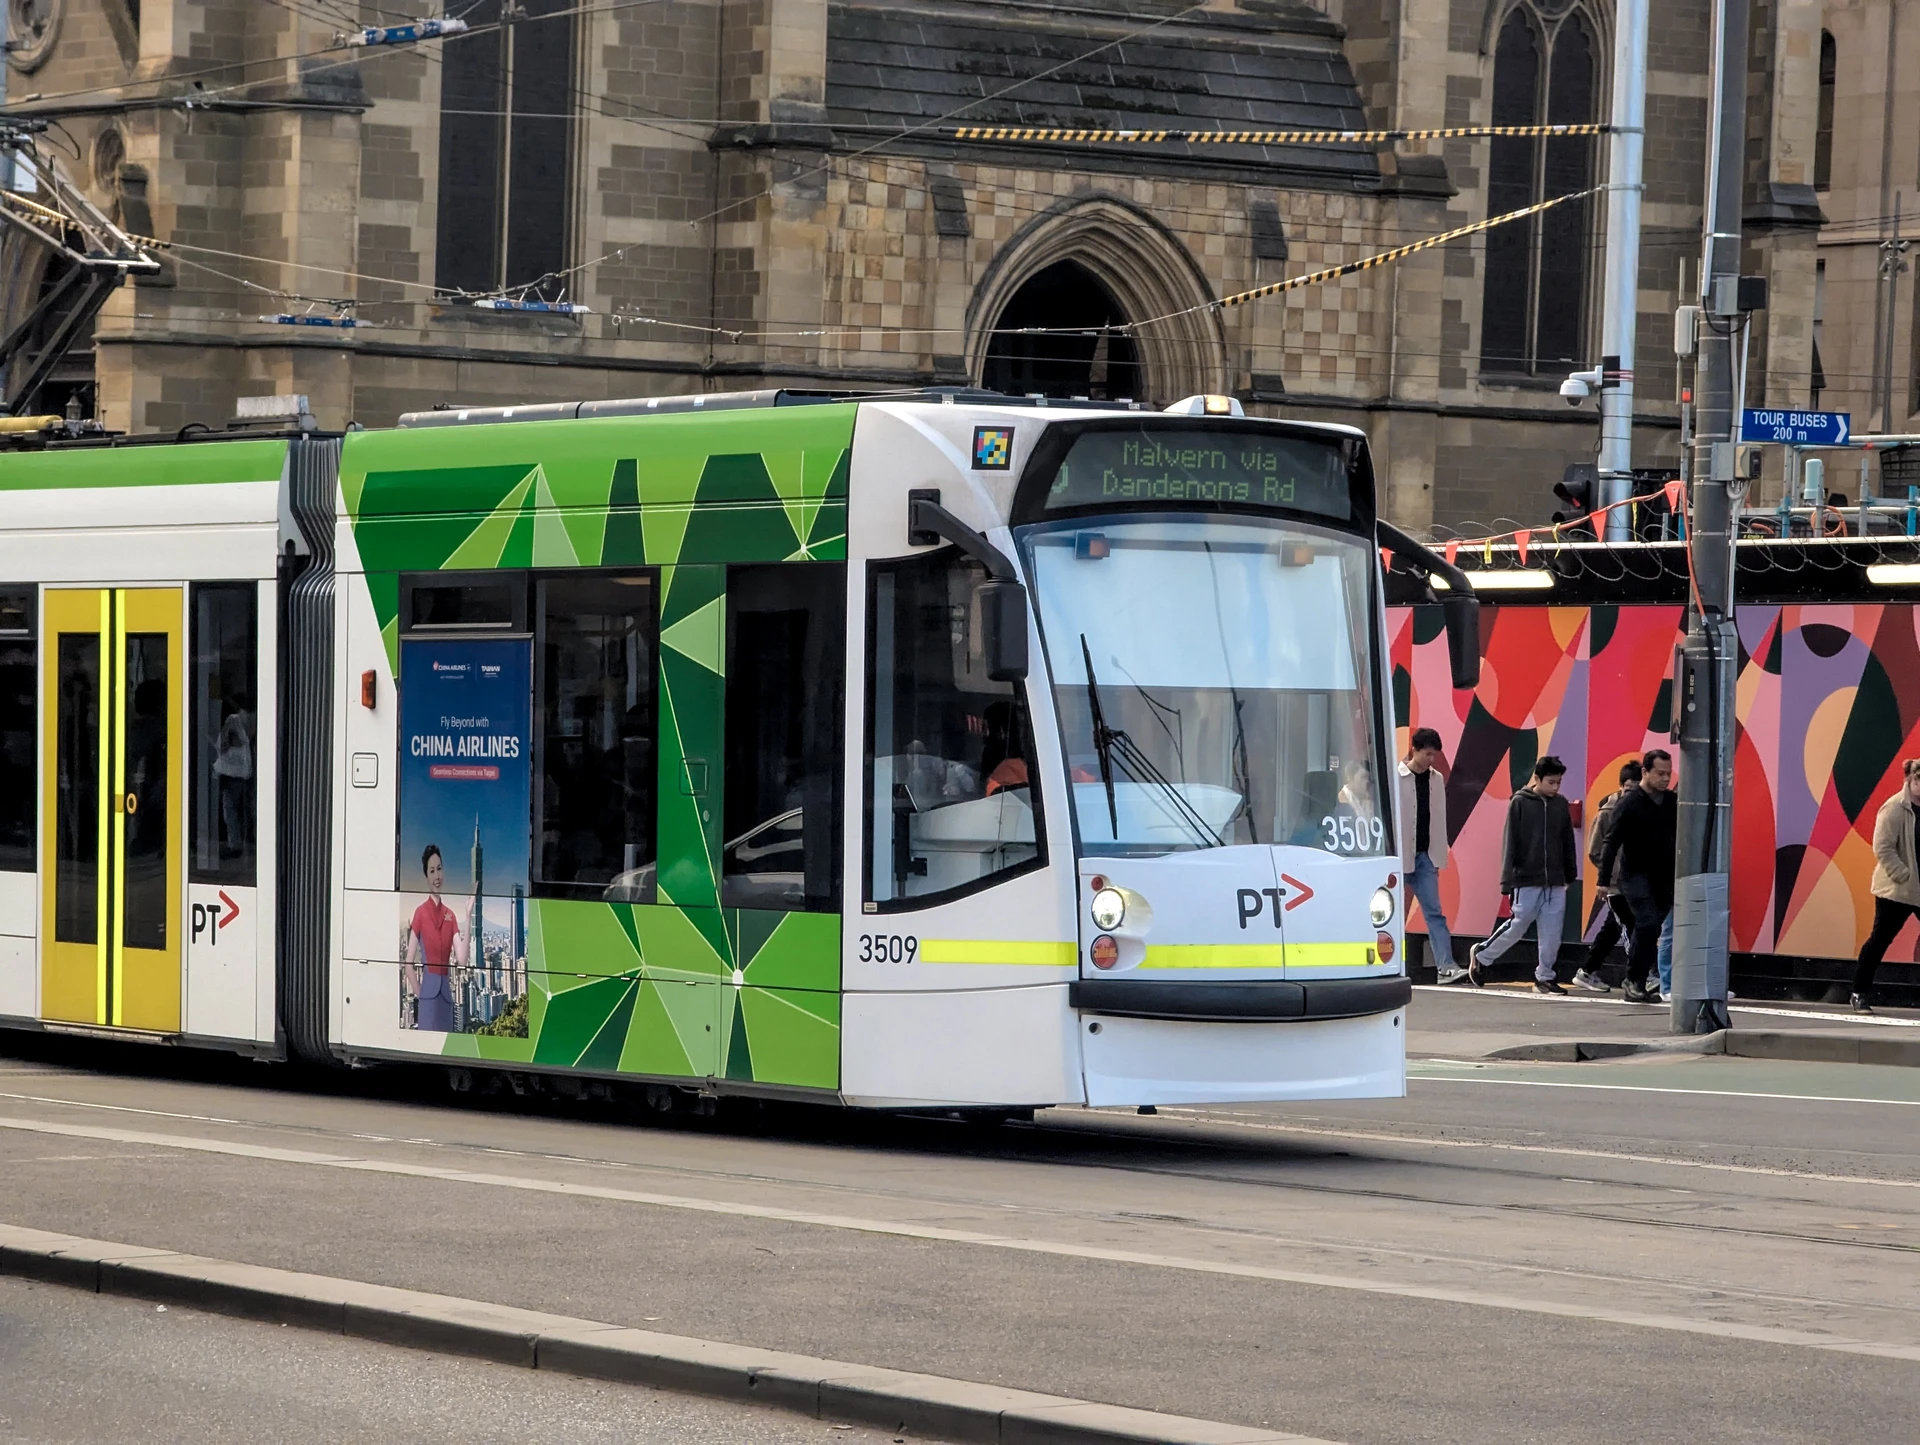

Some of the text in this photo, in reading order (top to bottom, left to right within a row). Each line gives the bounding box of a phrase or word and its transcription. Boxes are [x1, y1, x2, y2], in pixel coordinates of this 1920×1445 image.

[1753, 411, 1828, 428] TOUR BUSES
[1773, 427, 1807, 440] 200 m
[1123, 440, 1277, 471] Malvern via
[1103, 467, 1249, 500] Dandenong
[1264, 476, 1295, 501] Rd
[440, 716, 489, 730] Fly Beyond with
[411, 735, 520, 758] CHINA AIRLINES
[1321, 816, 1384, 852] 3509
[859, 934, 917, 963] 3509
